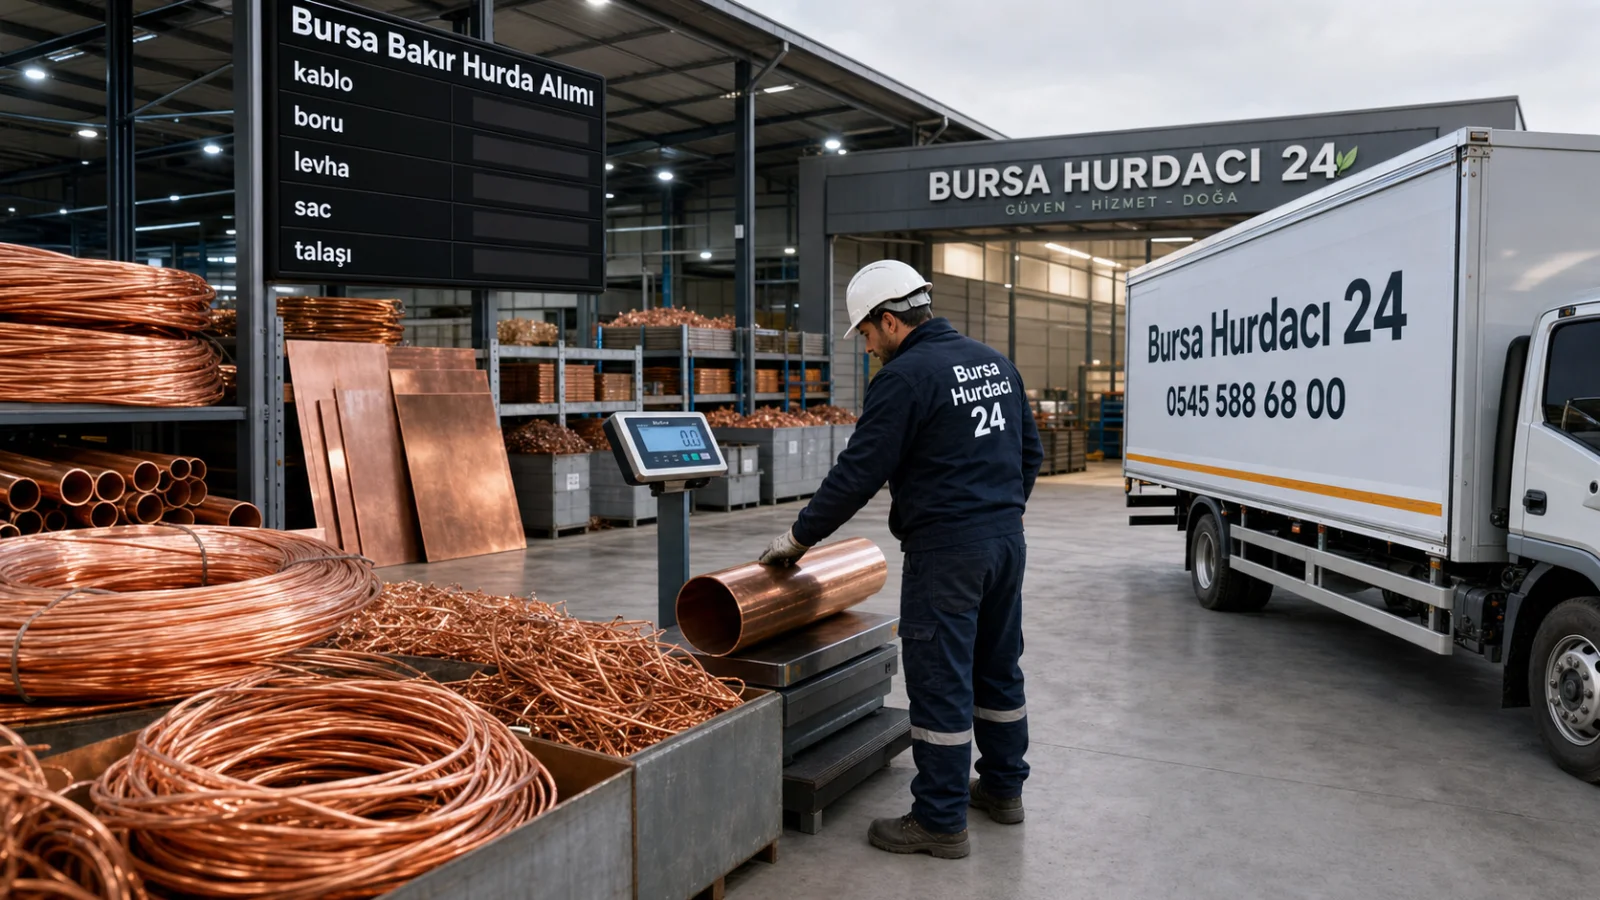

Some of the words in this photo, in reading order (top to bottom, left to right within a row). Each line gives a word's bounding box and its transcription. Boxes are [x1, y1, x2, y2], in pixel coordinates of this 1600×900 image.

[292, 6, 378, 53] Bursa
[388, 31, 456, 71] Bakır
[463, 52, 533, 92] Hurda
[540, 73, 594, 106] Alımı
[294, 61, 353, 92] kablo
[294, 105, 343, 133] boru
[294, 151, 349, 178] levha
[929, 164, 1050, 201] BURSA
[1064, 148, 1261, 193] HURDACI
[1281, 142, 1338, 182] 24
[294, 200, 331, 218] sac
[1005, 201, 1065, 216] GÜVEN
[1092, 196, 1157, 211] HİZMET
[1183, 189, 1238, 205] DOĞA
[294, 241, 351, 267] talaşı
[1148, 324, 1203, 363] Bursa
[1211, 296, 1330, 357] Hurdacı
[1343, 270, 1407, 345] 24
[953, 362, 1000, 383] Bursa
[1167, 385, 1209, 417] 0545
[1215, 382, 1256, 418] 588
[1264, 379, 1297, 419] 68
[1306, 377, 1346, 420] 00
[971, 402, 1006, 438] 24
